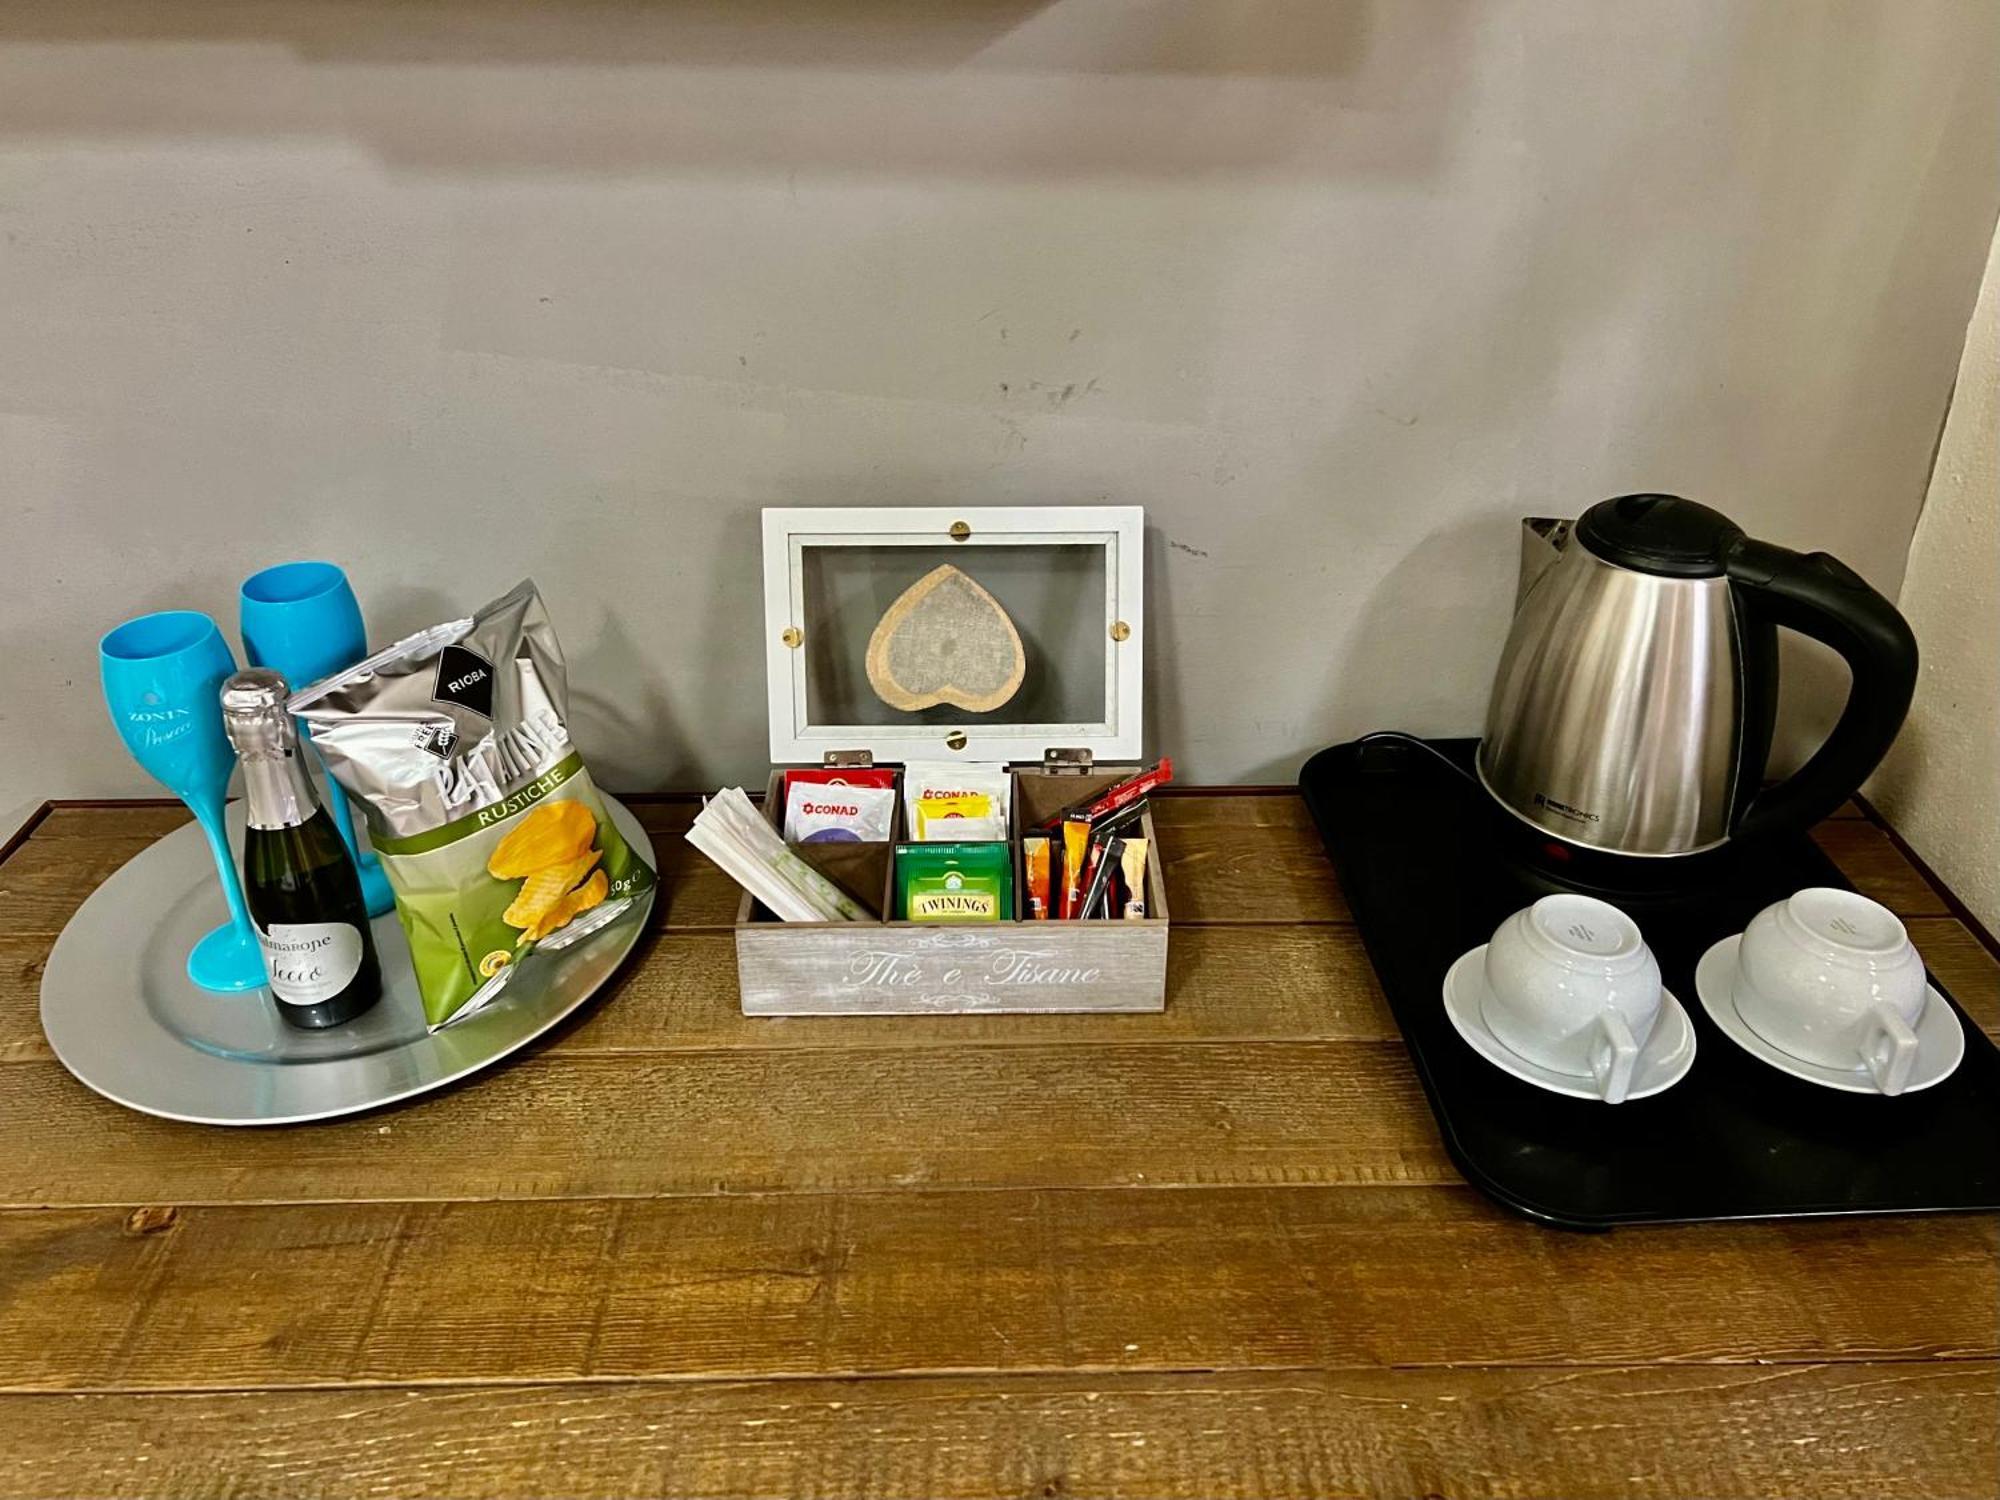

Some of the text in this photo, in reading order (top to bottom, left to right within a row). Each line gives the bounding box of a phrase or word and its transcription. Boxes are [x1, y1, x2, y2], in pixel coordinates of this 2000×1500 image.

[447, 668, 488, 694] RIOBA
[477, 768, 566, 827] RUSTICHE
[814, 804, 859, 816] CONAD
[919, 896, 989, 914] TWININGS
[842, 948, 1101, 986] Thè e Tisane
